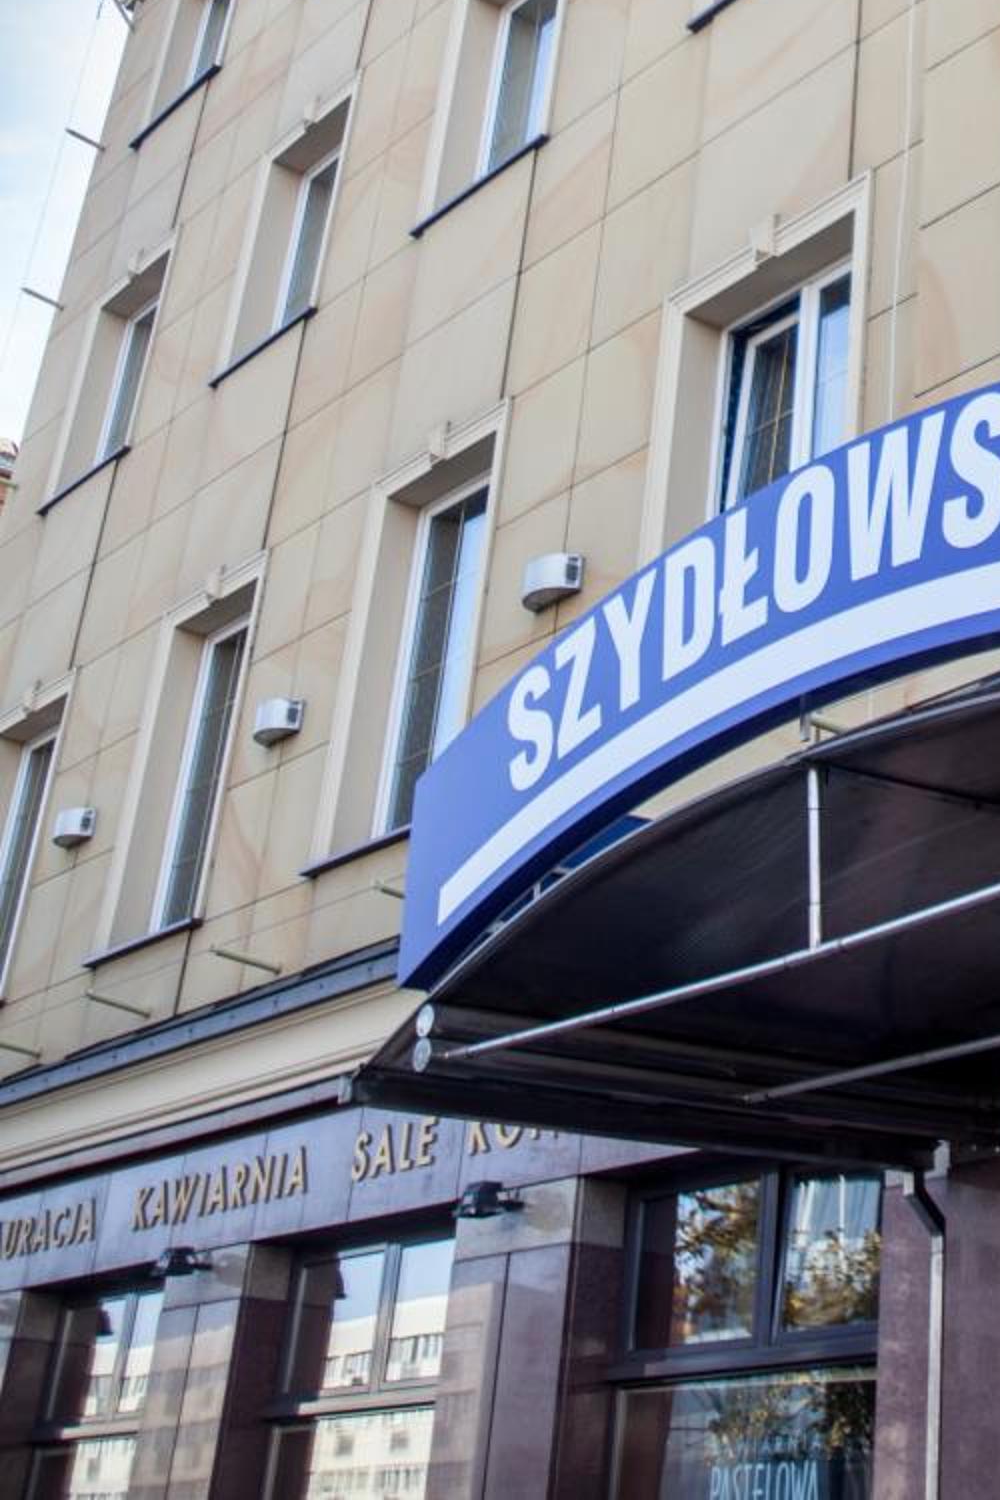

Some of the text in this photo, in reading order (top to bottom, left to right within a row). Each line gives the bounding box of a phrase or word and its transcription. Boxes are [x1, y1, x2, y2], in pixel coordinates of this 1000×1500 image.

[0, 1197, 97, 1261] URACJA
[132, 1145, 309, 1231] KAWIARNIA
[351, 1115, 439, 1183] SALE
